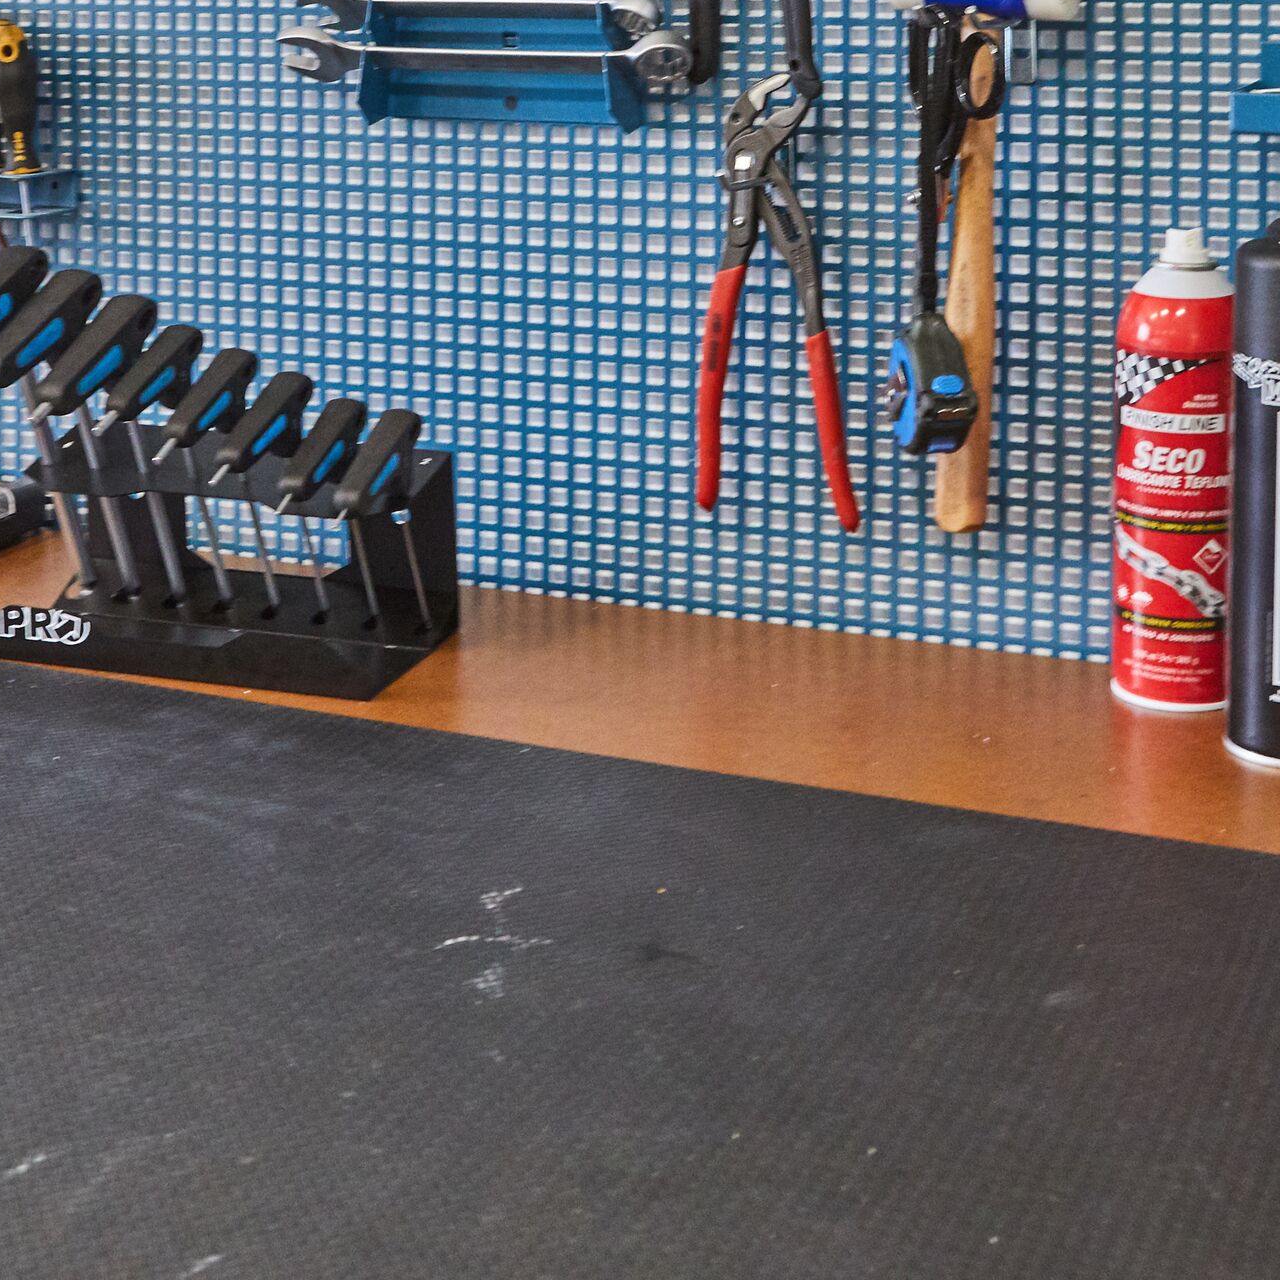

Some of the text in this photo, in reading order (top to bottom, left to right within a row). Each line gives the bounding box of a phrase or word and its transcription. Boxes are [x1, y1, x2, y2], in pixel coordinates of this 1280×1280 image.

[1124, 409, 1220, 432] FINISH LINE
[1132, 440, 1207, 474] SECO
